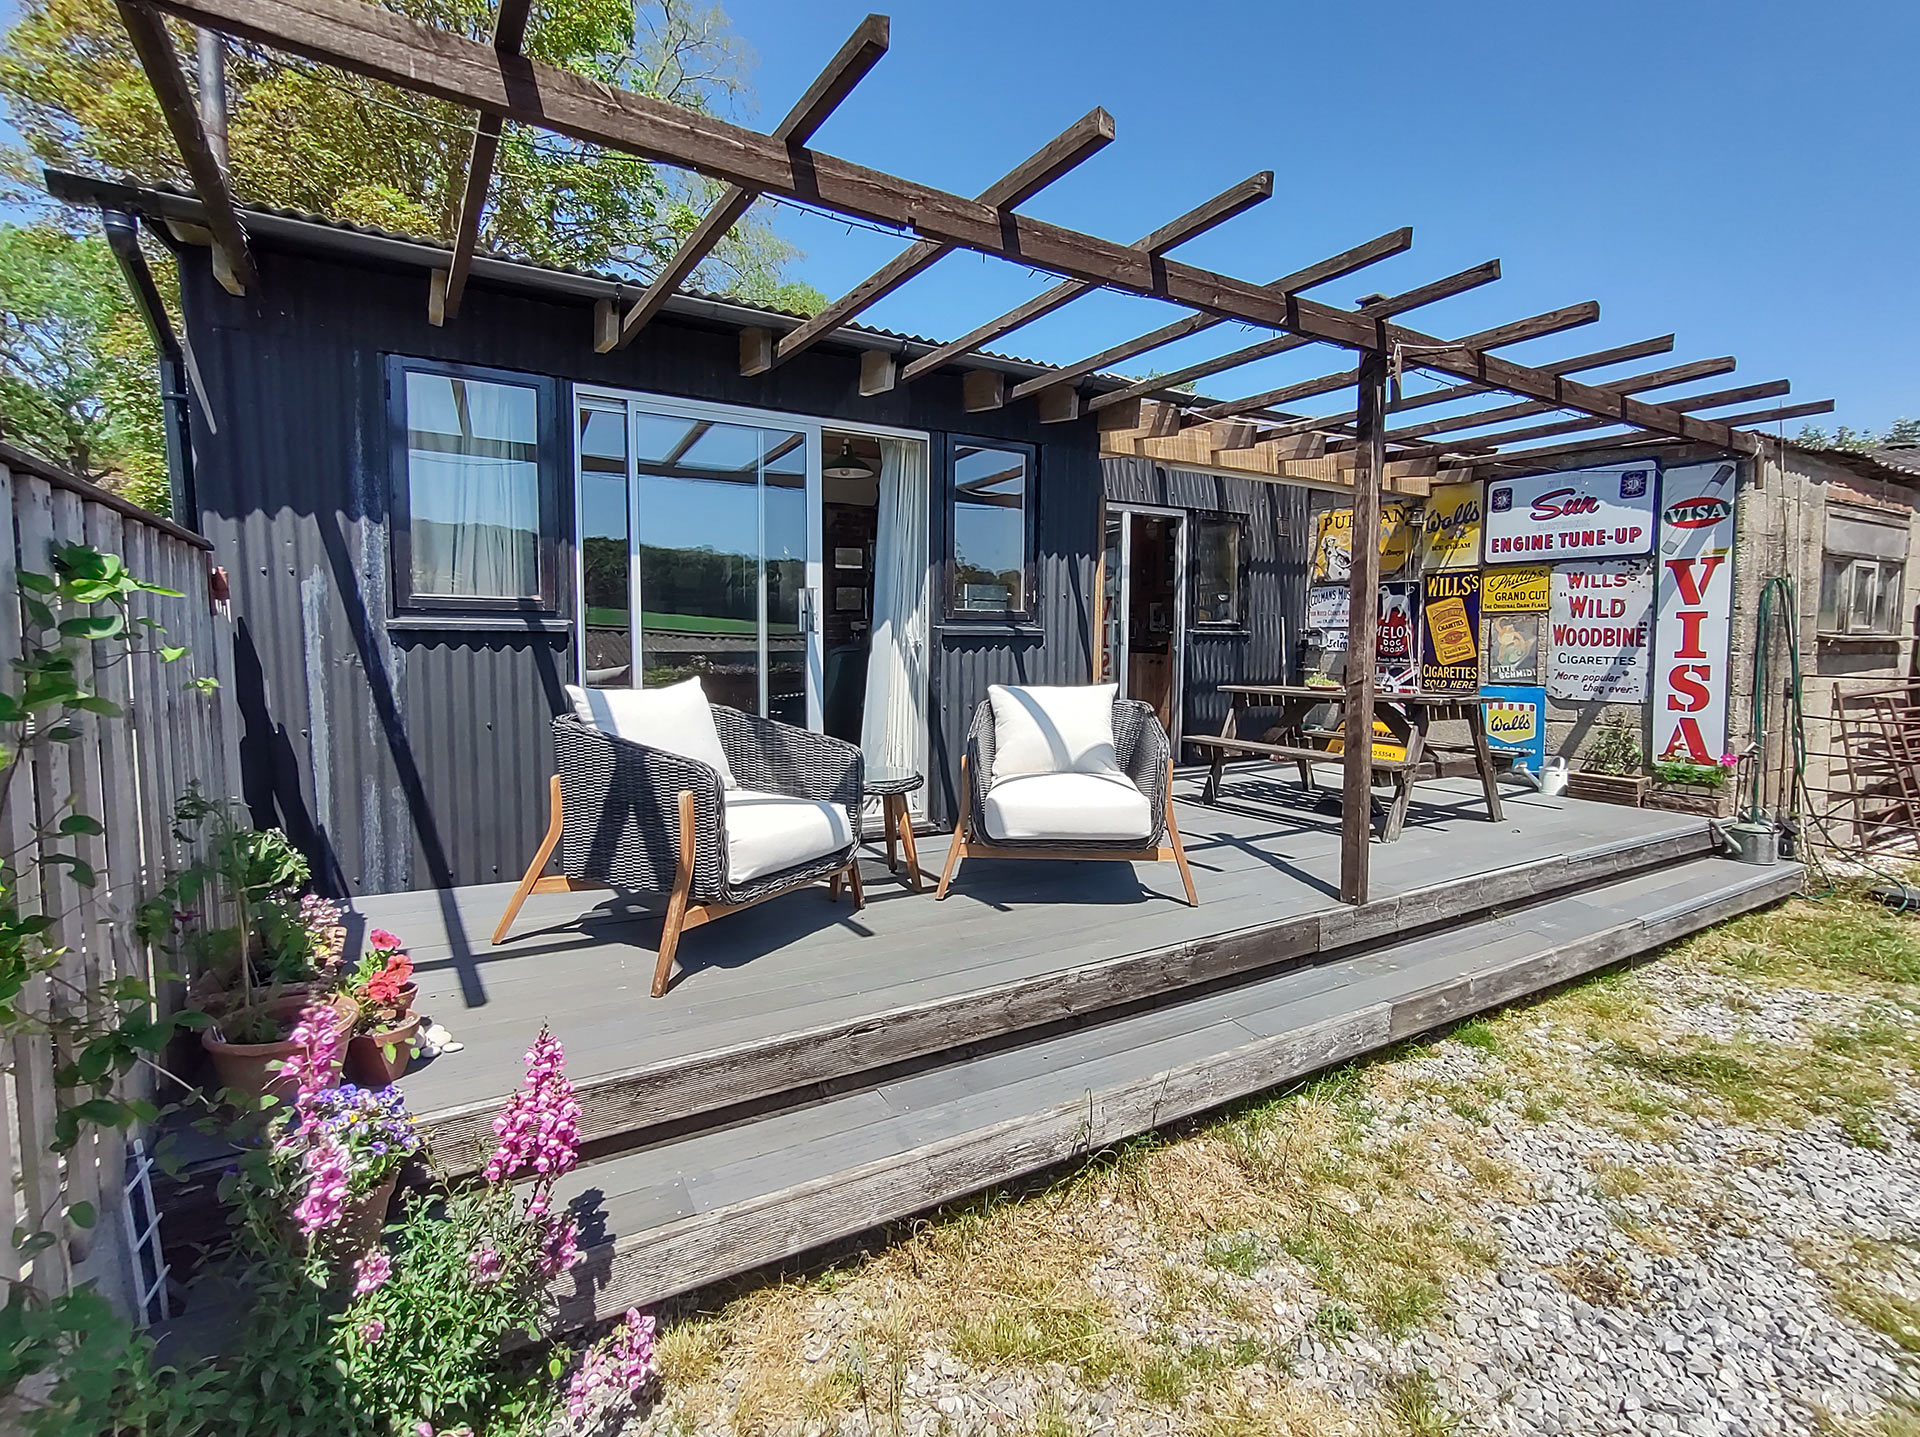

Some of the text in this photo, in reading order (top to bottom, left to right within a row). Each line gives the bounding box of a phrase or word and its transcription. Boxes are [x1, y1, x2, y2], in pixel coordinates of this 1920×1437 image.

[1529, 488, 1600, 520] Sun
[1667, 503, 1727, 524] VISA
[1491, 526, 1643, 553] ENGINE TUNE-UP
[1495, 590, 1547, 601] GRAND CUT
[1380, 645, 1405, 653] FOODS
[1558, 652, 1637, 665] CIGARETTES
[1657, 555, 1725, 766] VISA
[1423, 664, 1477, 680] CIGARETTES
[1581, 672, 1621, 683] popular
[1423, 679, 1476, 689] SOLD HERE
[1491, 714, 1530, 732] Wall's
